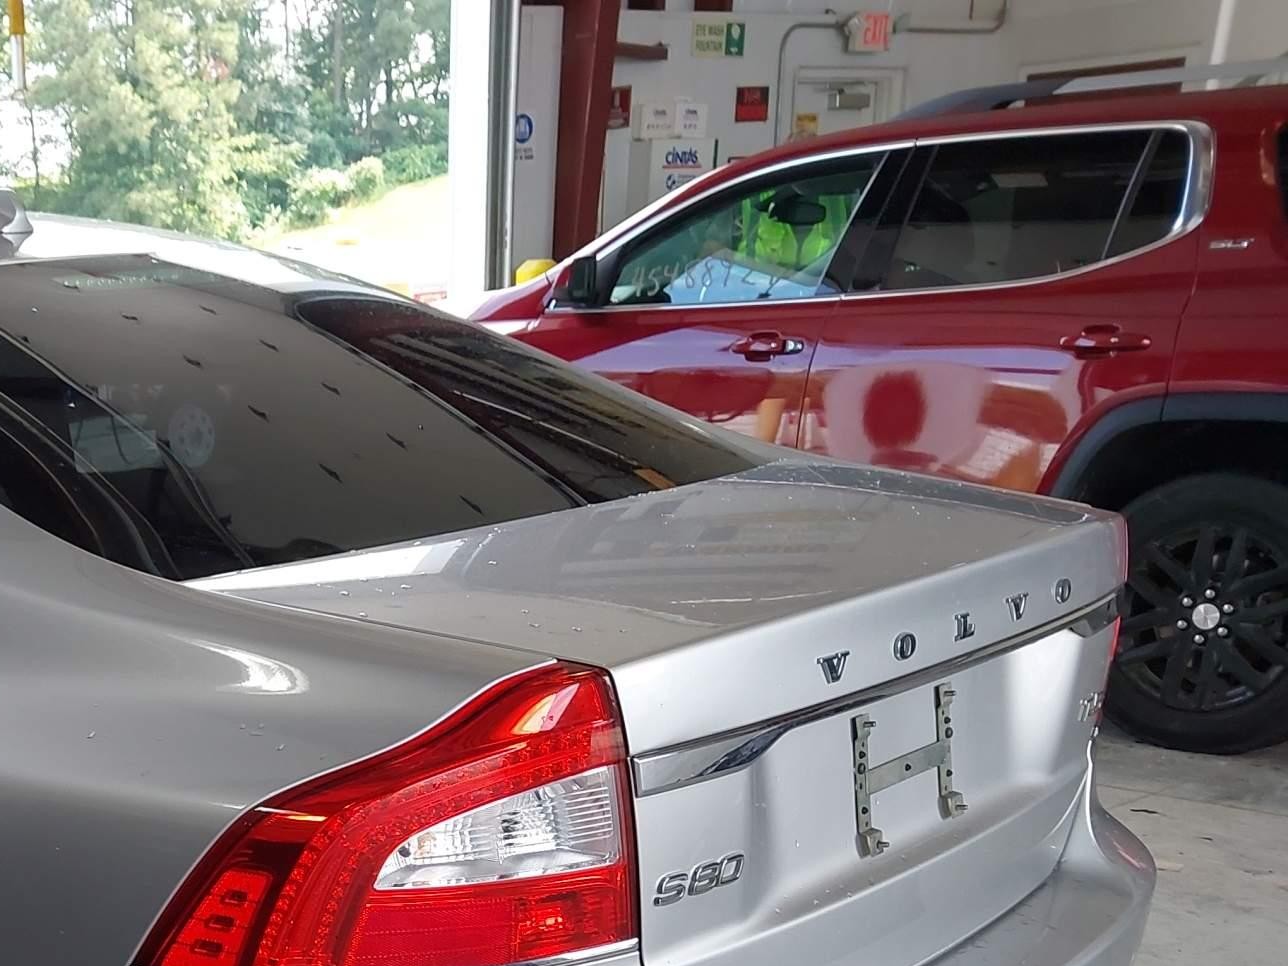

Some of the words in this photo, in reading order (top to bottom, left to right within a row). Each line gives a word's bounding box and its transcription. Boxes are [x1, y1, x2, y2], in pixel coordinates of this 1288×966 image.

[695, 24, 708, 37] EYE
[708, 24, 724, 37] WASH
[864, 14, 890, 46] EXIT
[695, 39, 723, 52] FOUNTAIN
[816, 577, 1073, 684] VOLVO
